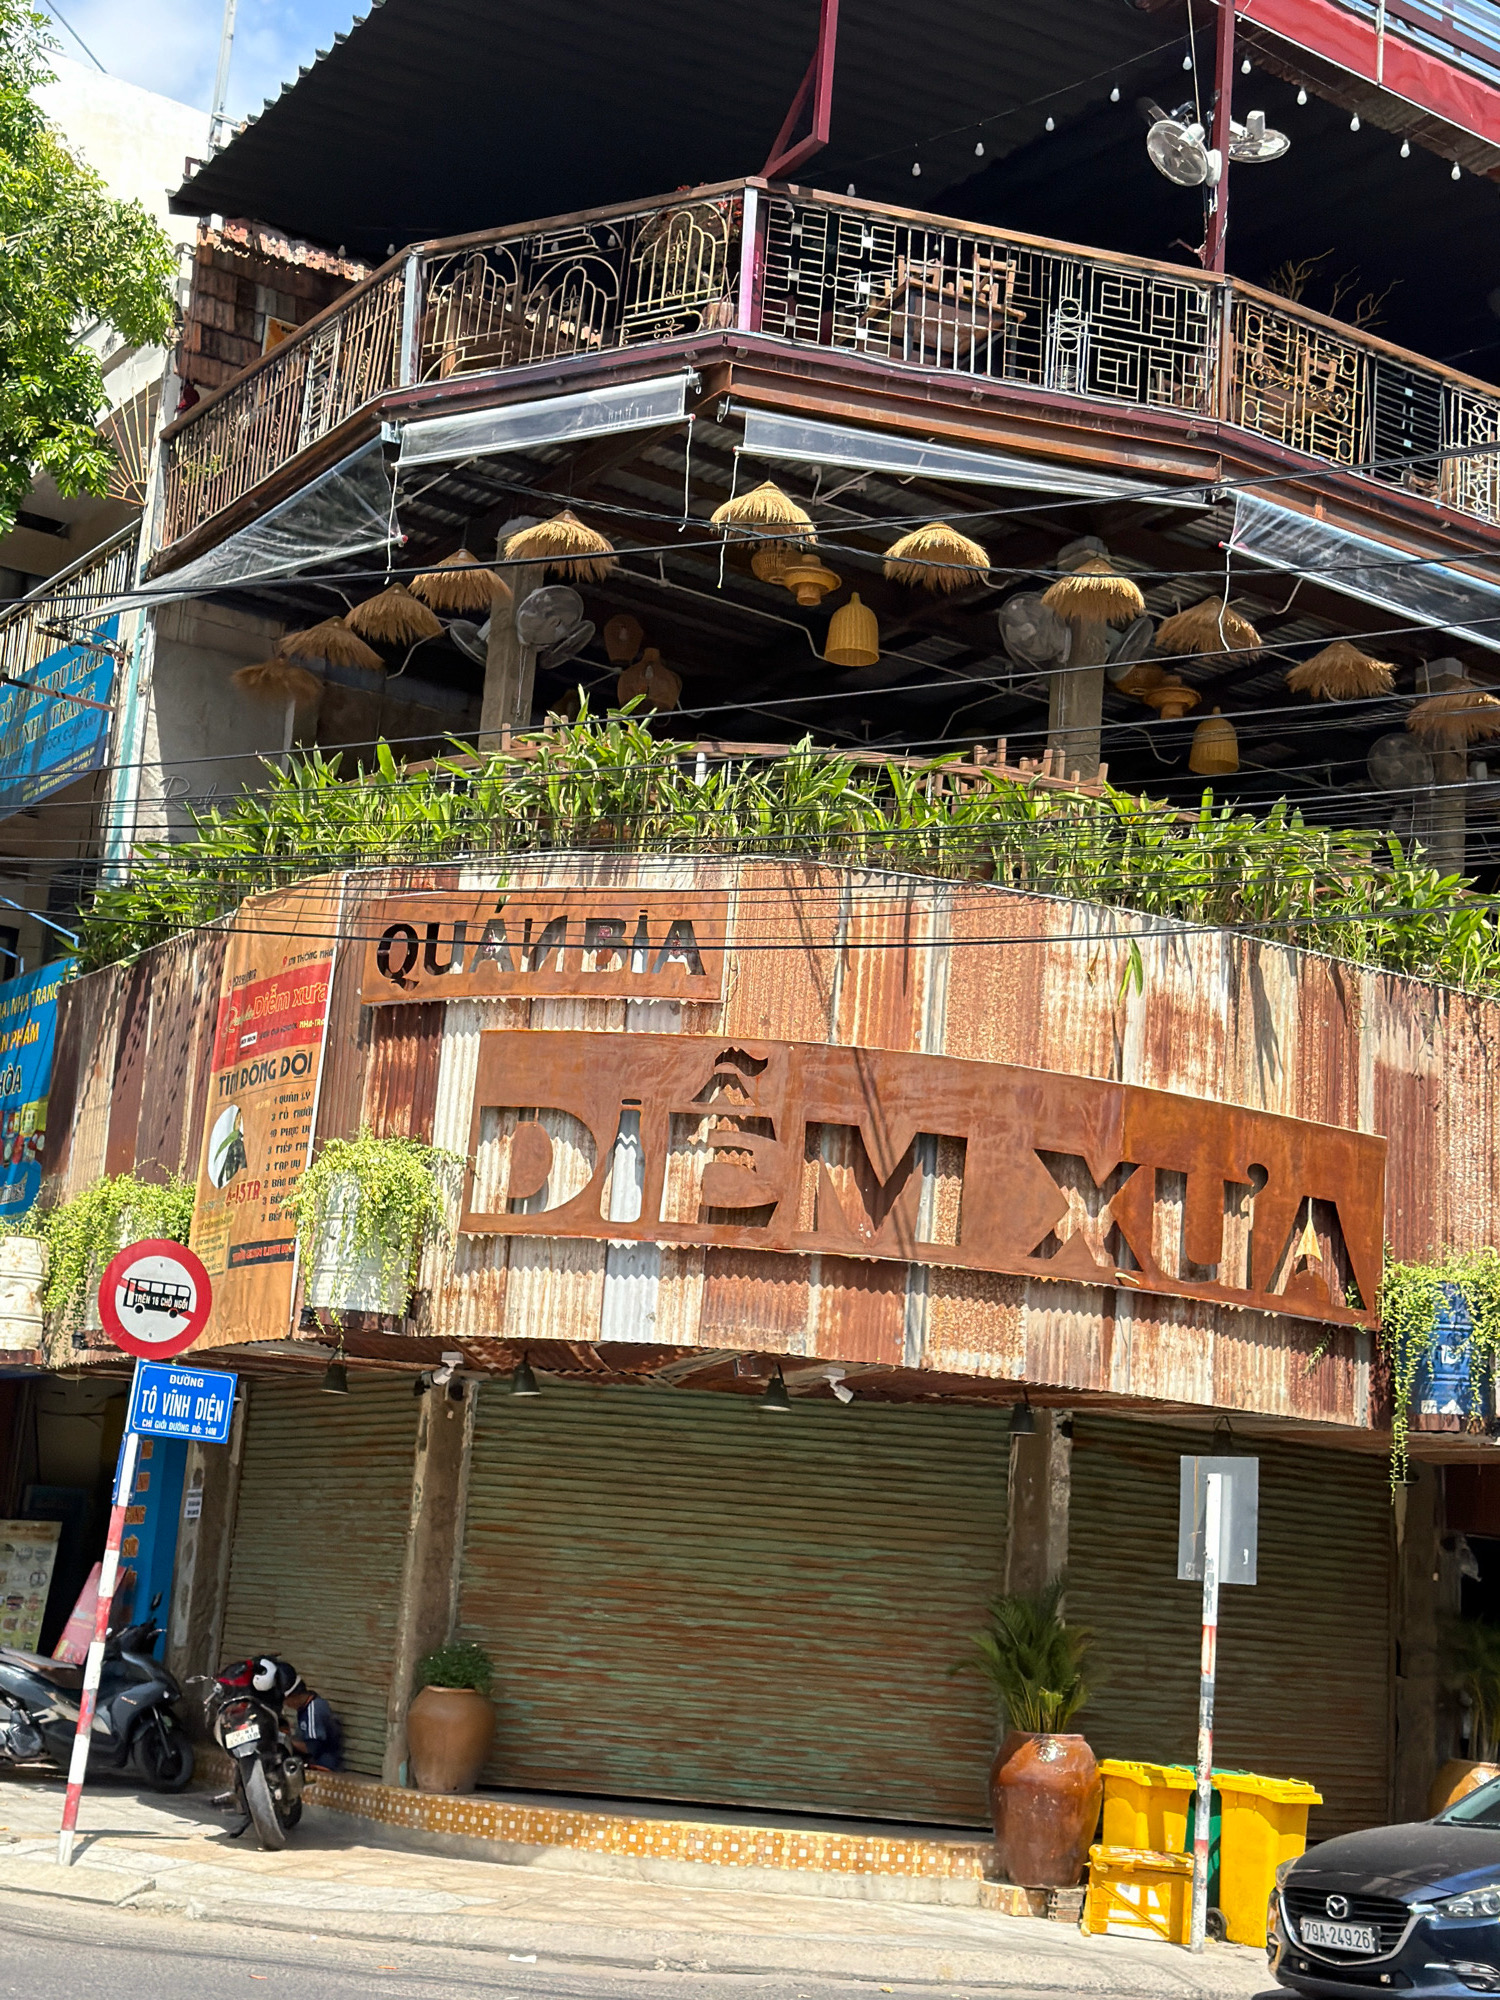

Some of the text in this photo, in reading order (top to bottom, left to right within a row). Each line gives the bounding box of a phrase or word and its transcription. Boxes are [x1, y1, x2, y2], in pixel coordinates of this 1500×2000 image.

[51, 663, 70, 690] DU
[1027, 1149, 1367, 1311] XƯA
[135, 1293, 150, 1304] TRÊN
[152, 1296, 159, 1306] 16
[169, 1373, 204, 1388] ĐƯỜNG
[141, 1384, 224, 1426] TÔ VĨNH DIỆN
[141, 1416, 153, 1428] CHỈ
